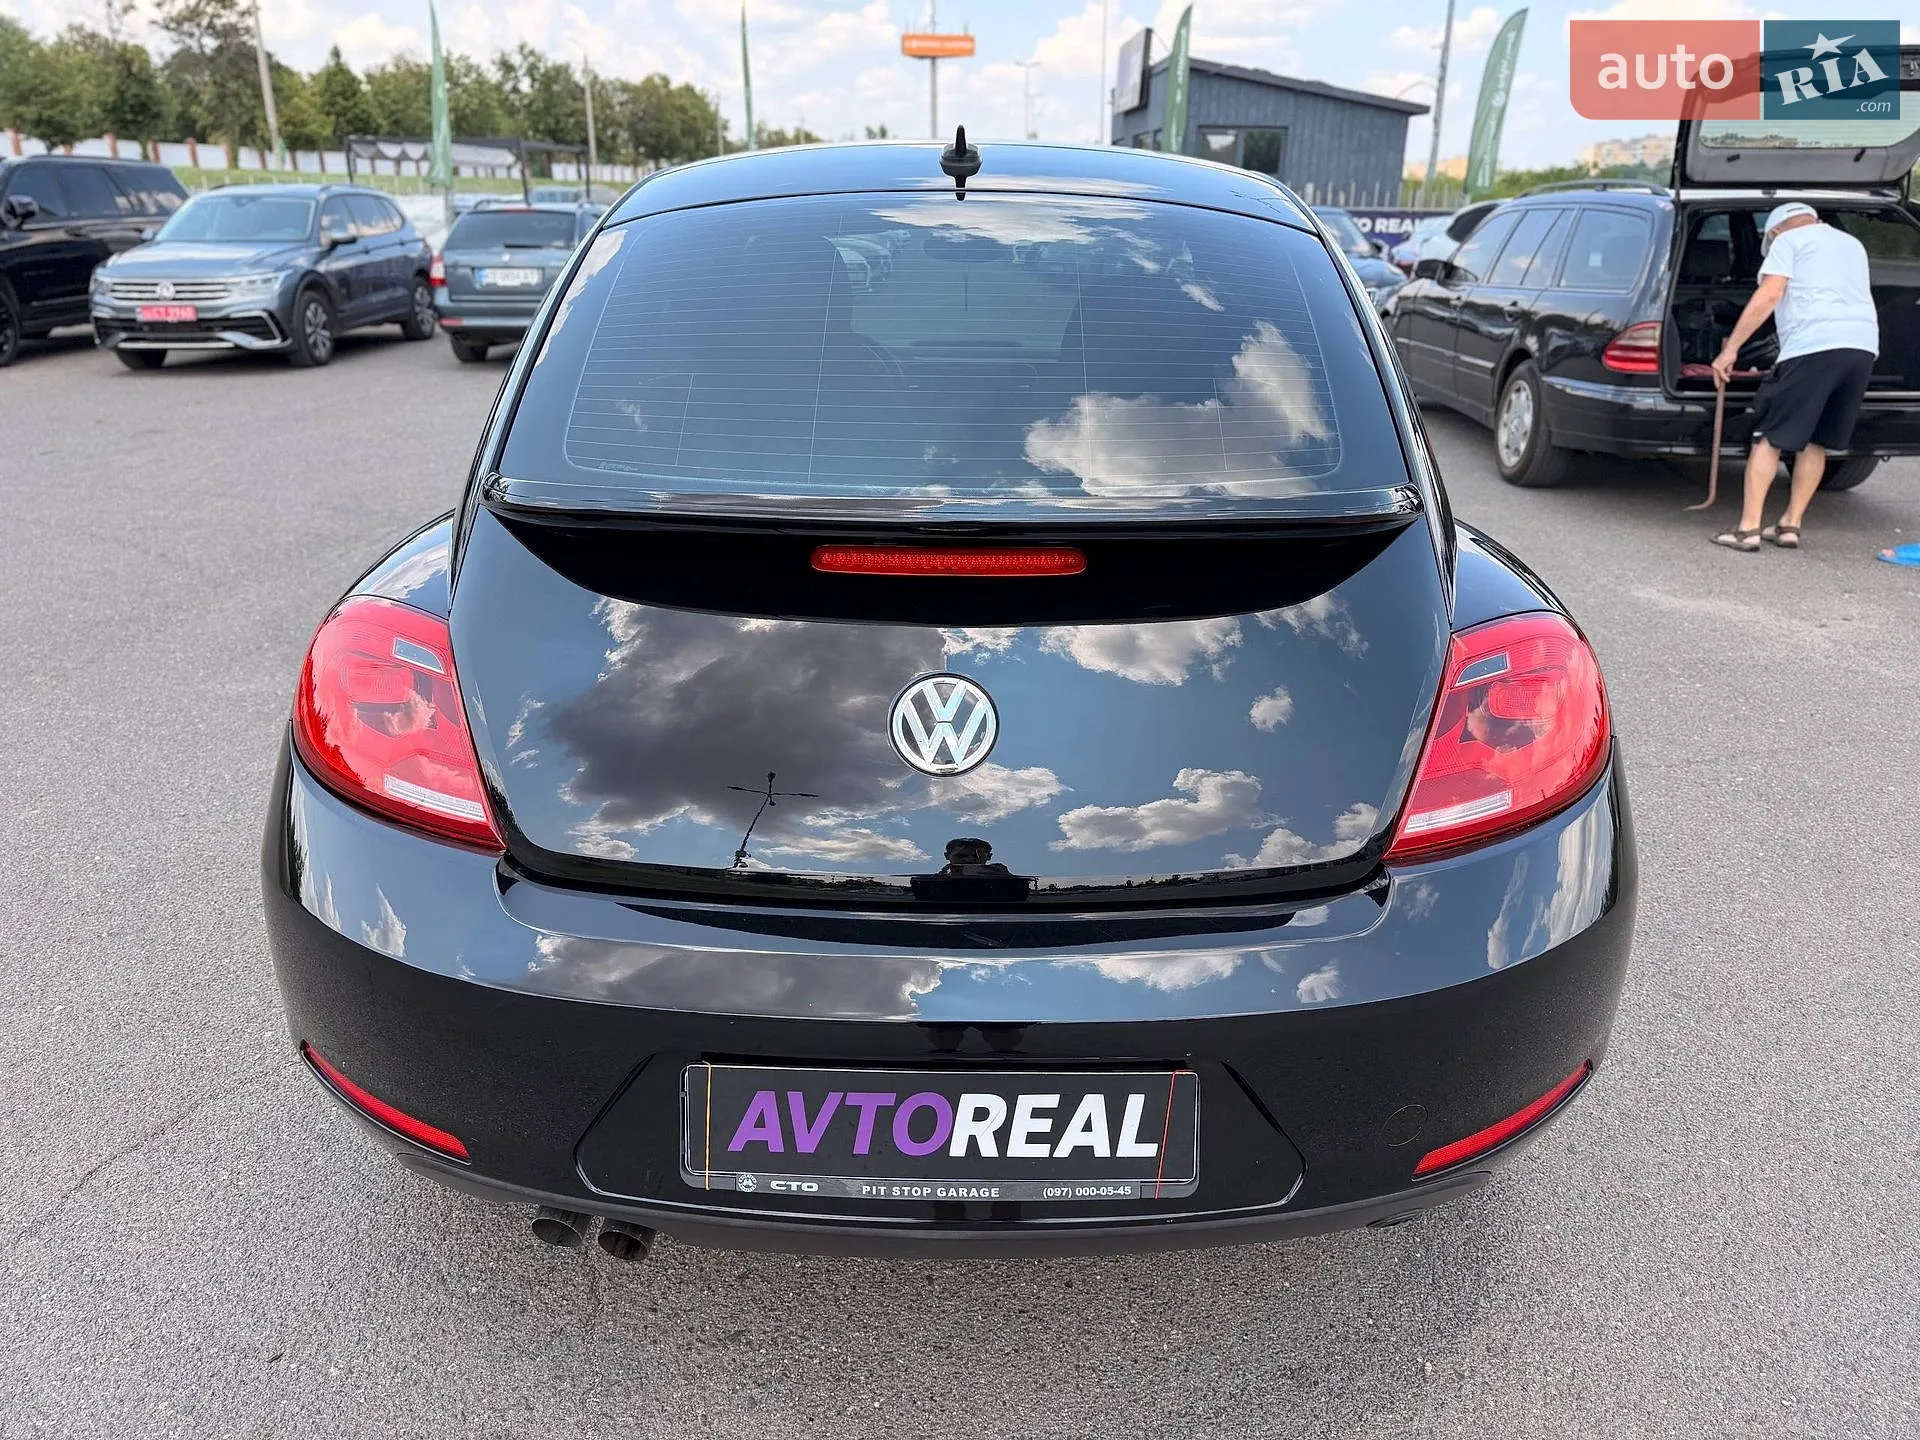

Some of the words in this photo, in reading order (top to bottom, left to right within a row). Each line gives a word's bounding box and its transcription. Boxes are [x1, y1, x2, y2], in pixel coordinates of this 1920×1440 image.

[1353, 217, 1373, 233] O
[727, 1090, 1159, 1158] AVTOREAL
[862, 1185, 887, 1196] PIT
[891, 1186, 932, 1197] STOP
[936, 1187, 1000, 1198] GARAGE
[1043, 1187, 1072, 1198] (097)
[1075, 1186, 1132, 1196] 000-05-45
